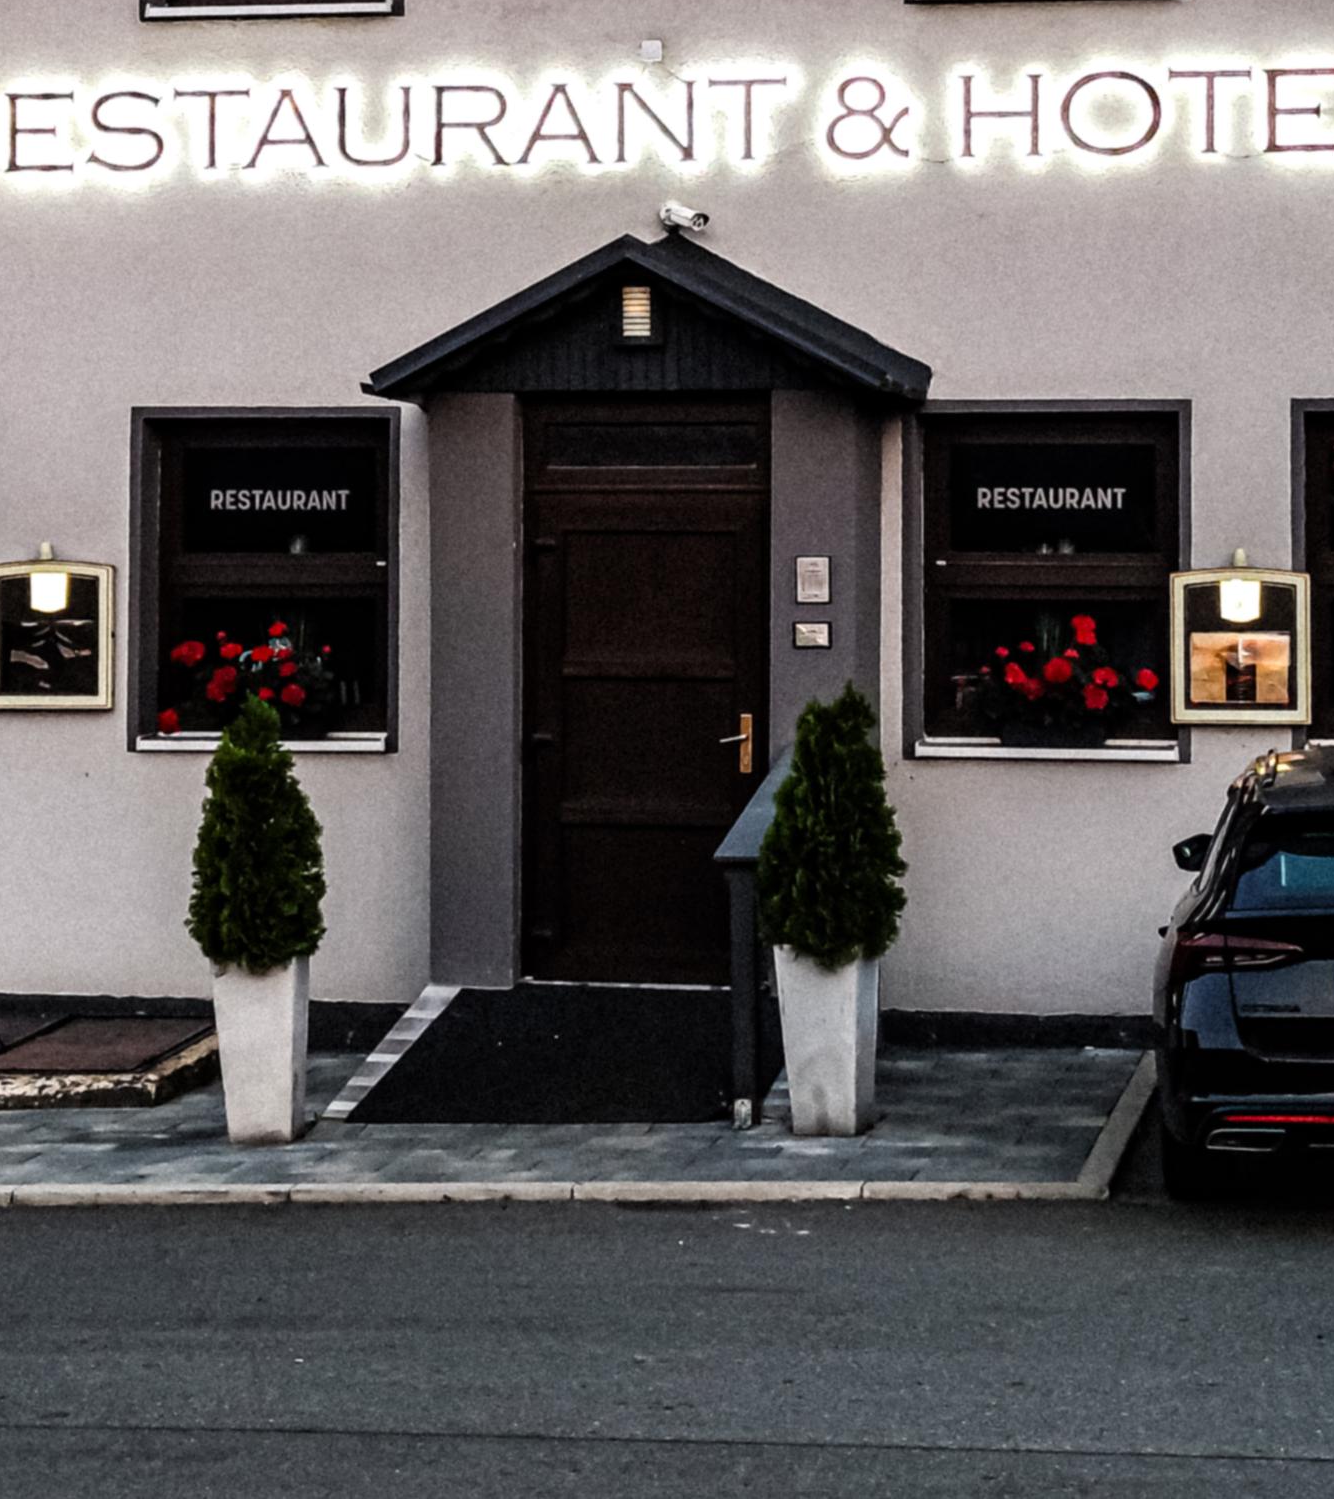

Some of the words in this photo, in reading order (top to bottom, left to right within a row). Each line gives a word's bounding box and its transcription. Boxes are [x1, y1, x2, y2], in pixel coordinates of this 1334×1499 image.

[825, 76, 910, 160] &
[210, 489, 350, 511] RESTAURANT
[976, 487, 1127, 510] RESTAURANT
